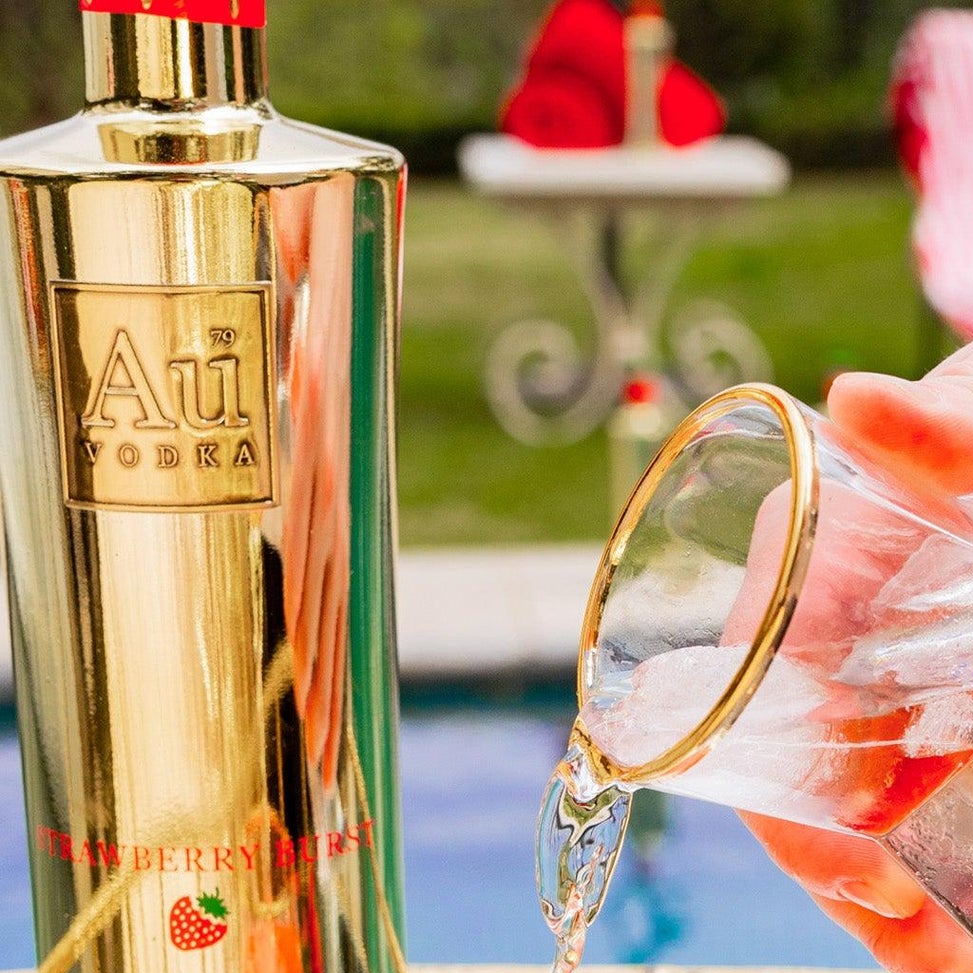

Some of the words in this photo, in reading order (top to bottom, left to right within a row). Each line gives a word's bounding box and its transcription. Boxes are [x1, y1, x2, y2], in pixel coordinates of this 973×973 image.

[210, 328, 236, 349] 79
[81, 329, 250, 434] Au
[84, 443, 257, 467] VODKA
[276, 819, 376, 869] BURST
